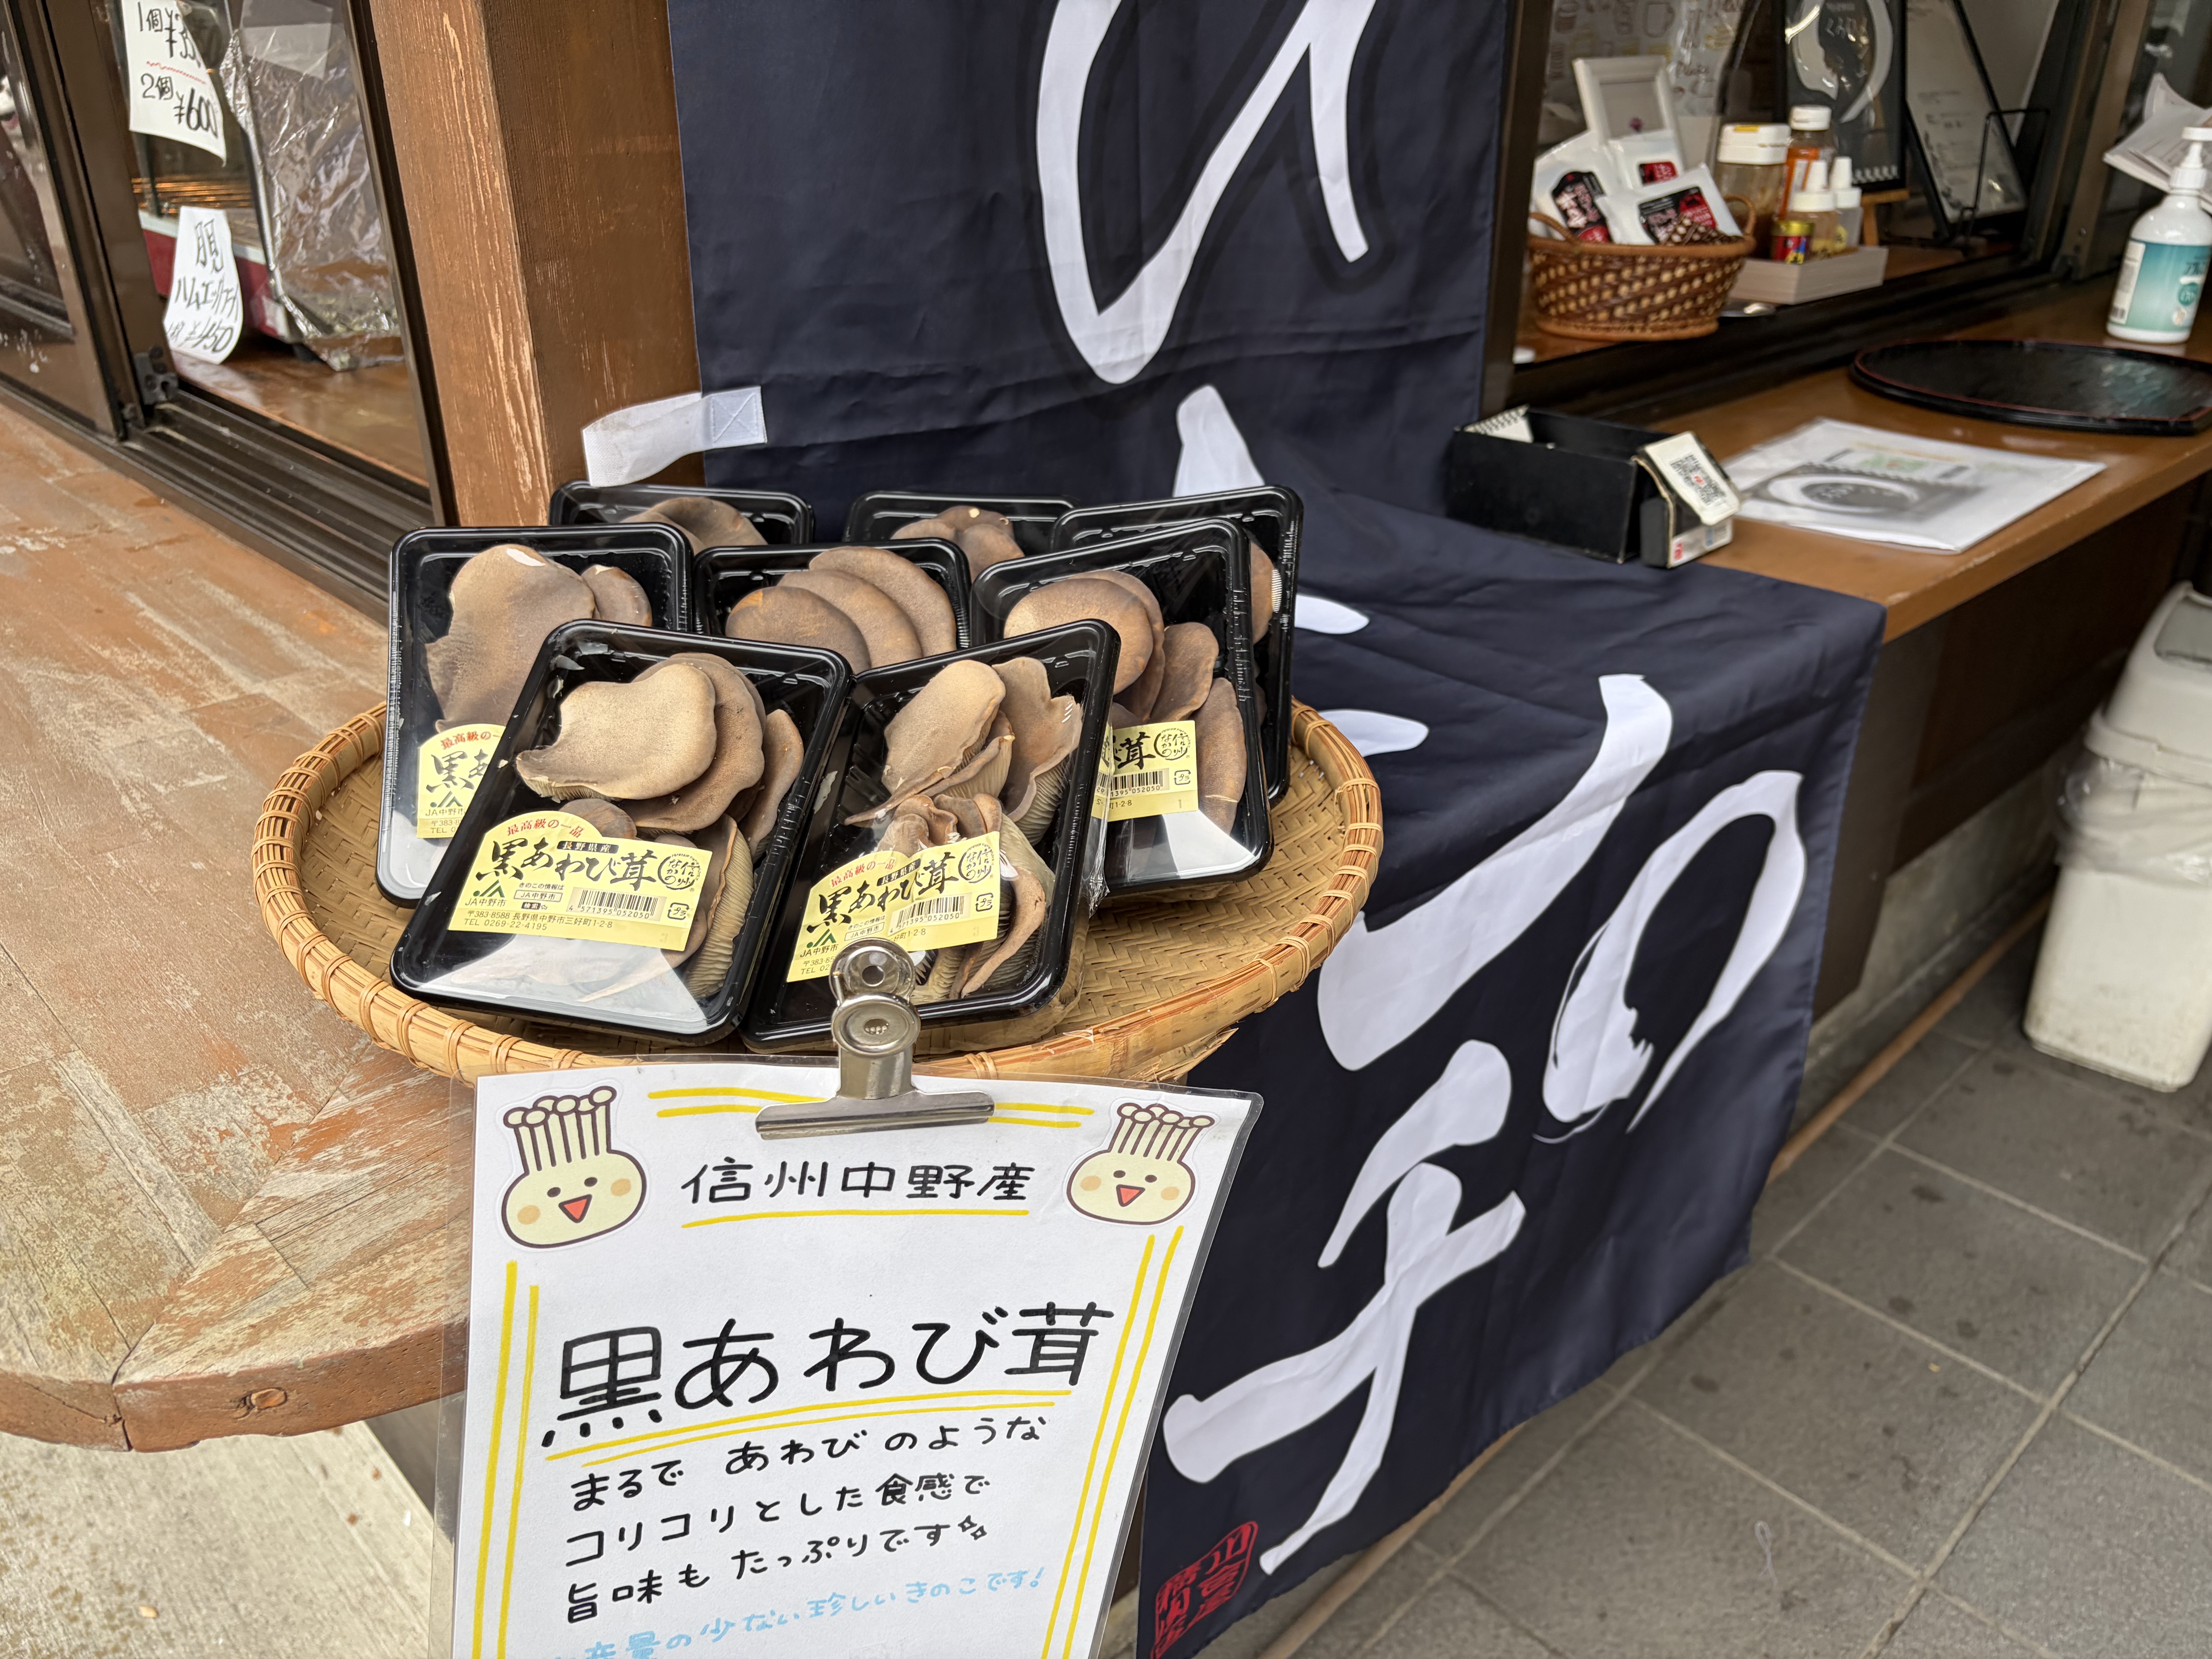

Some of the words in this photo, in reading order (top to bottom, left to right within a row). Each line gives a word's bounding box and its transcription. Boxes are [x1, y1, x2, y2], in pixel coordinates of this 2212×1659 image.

[141, 73, 174, 100] 2個
[1132, 785, 1160, 794] 052050
[507, 818, 584, 838] 最高級の一品
[562, 841, 611, 853] 長野県産
[476, 837, 658, 891] 黒あわび茸
[830, 859, 895, 887] 最高級の一品
[807, 852, 959, 933] 黒あわび茸
[465, 898, 507, 907] JA中野市
[980, 898, 992, 907] プラ
[467, 910, 510, 920] 〒383-8588
[580, 907, 612, 915] 571395
[617, 910, 649, 919] 052050
[673, 907, 687, 916] プラ
[484, 919, 547, 930] 0269-22-4195
[848, 915, 885, 929] きのこの情報は
[898, 916, 924, 929] 571395
[927, 913, 959, 921] 052050
[850, 926, 879, 938] JA中野市
[800, 944, 838, 957] JA中野市
[682, 1156, 1035, 1204] 信州中野産
[542, 1301, 1115, 1448] 黒あわび茸
[571, 1459, 684, 1511] まるで
[567, 1473, 991, 1568] コリコリとした食感で
